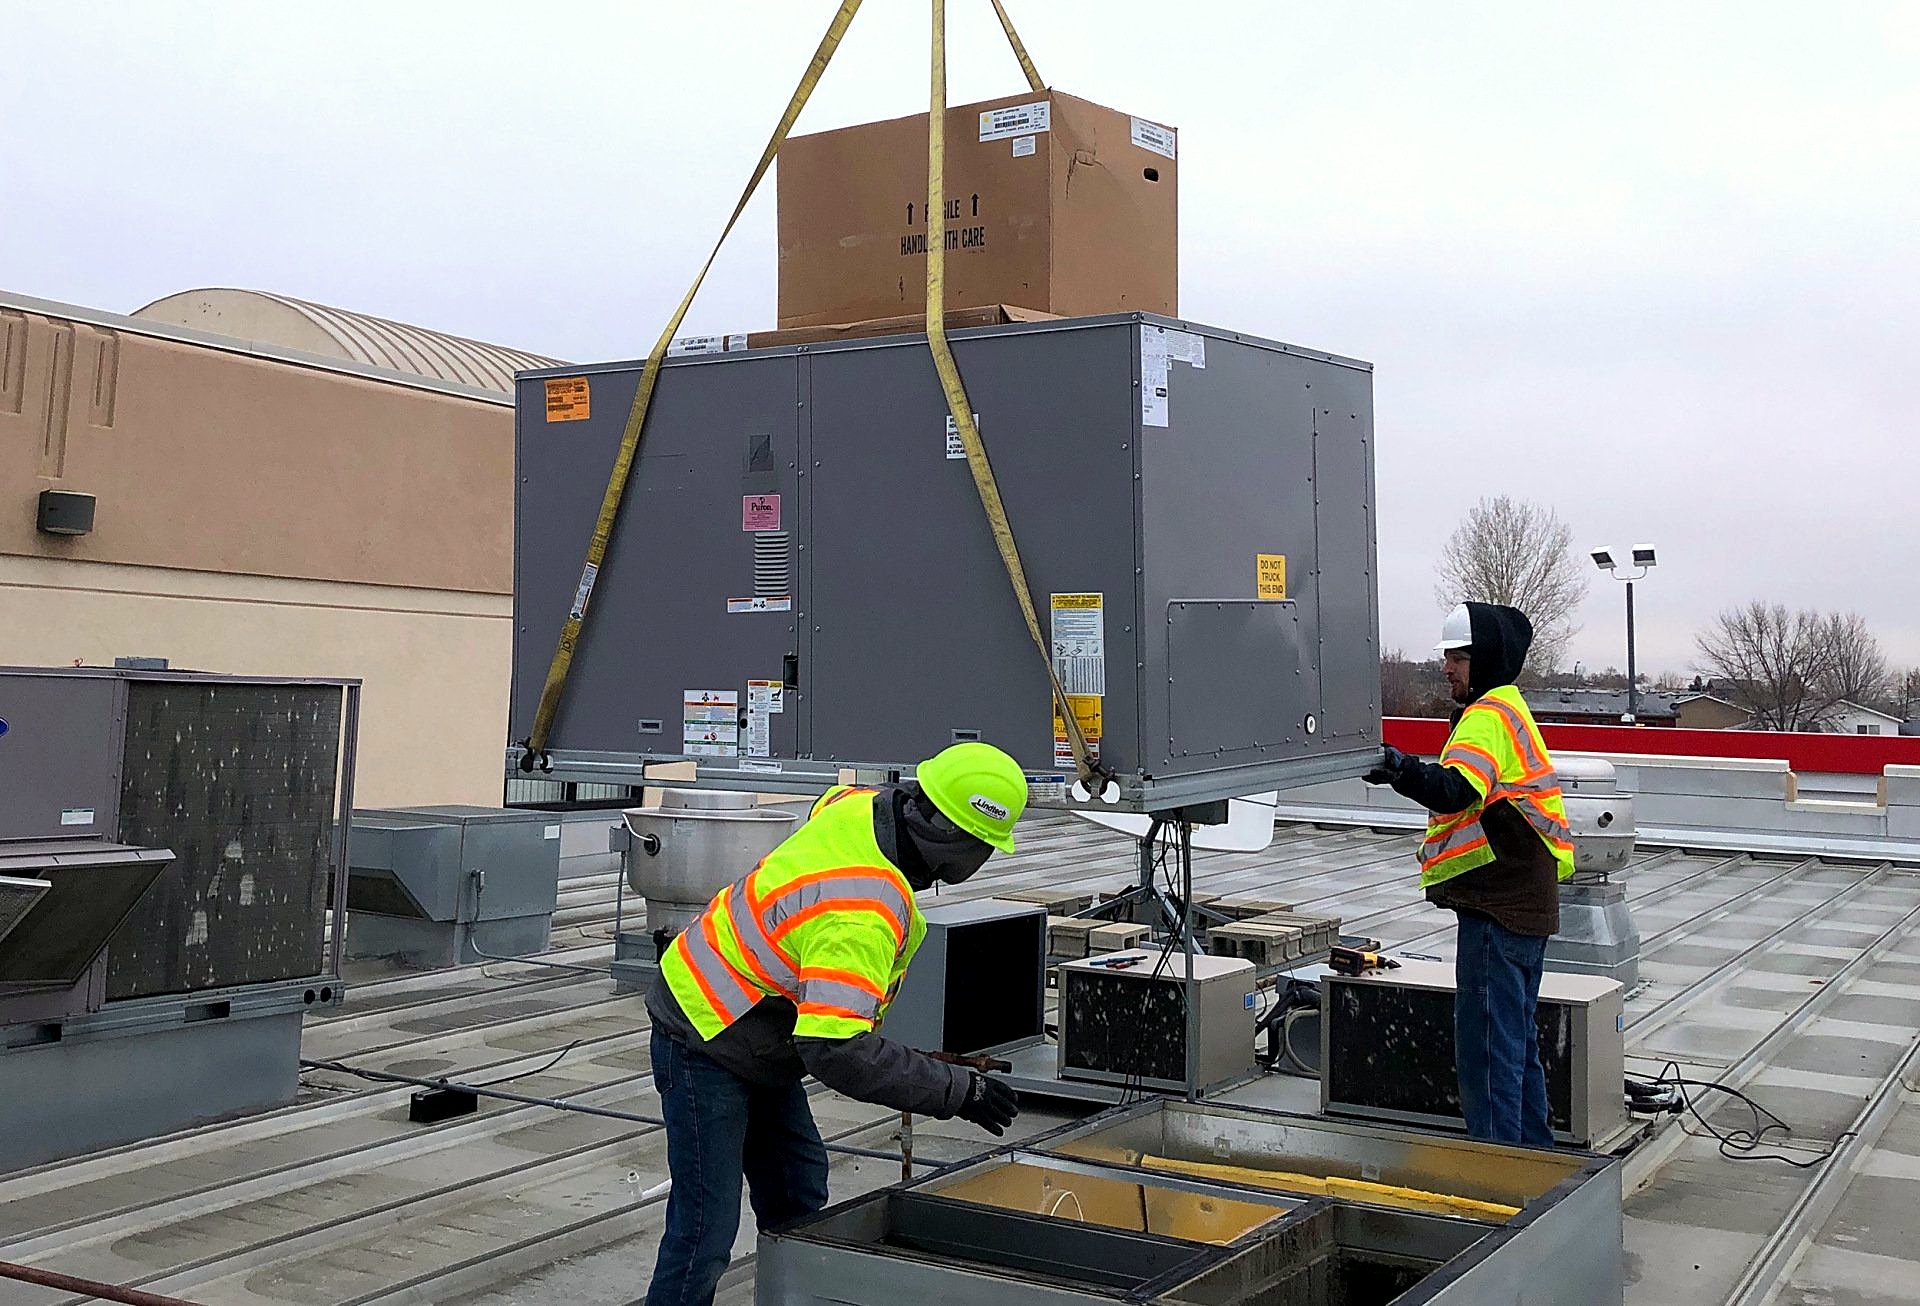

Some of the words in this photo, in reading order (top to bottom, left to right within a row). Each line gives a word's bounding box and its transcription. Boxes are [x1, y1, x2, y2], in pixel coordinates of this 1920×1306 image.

[924, 199, 960, 223] FILE
[900, 233, 930, 256] HANDL
[940, 229, 958, 250] ITH
[961, 226, 985, 249] CARE
[1260, 560, 1269, 569] DO
[1270, 560, 1281, 569] NOT
[1261, 572, 1281, 582] TRUCK
[1259, 584, 1272, 594] THIS
[1272, 584, 1284, 594] END
